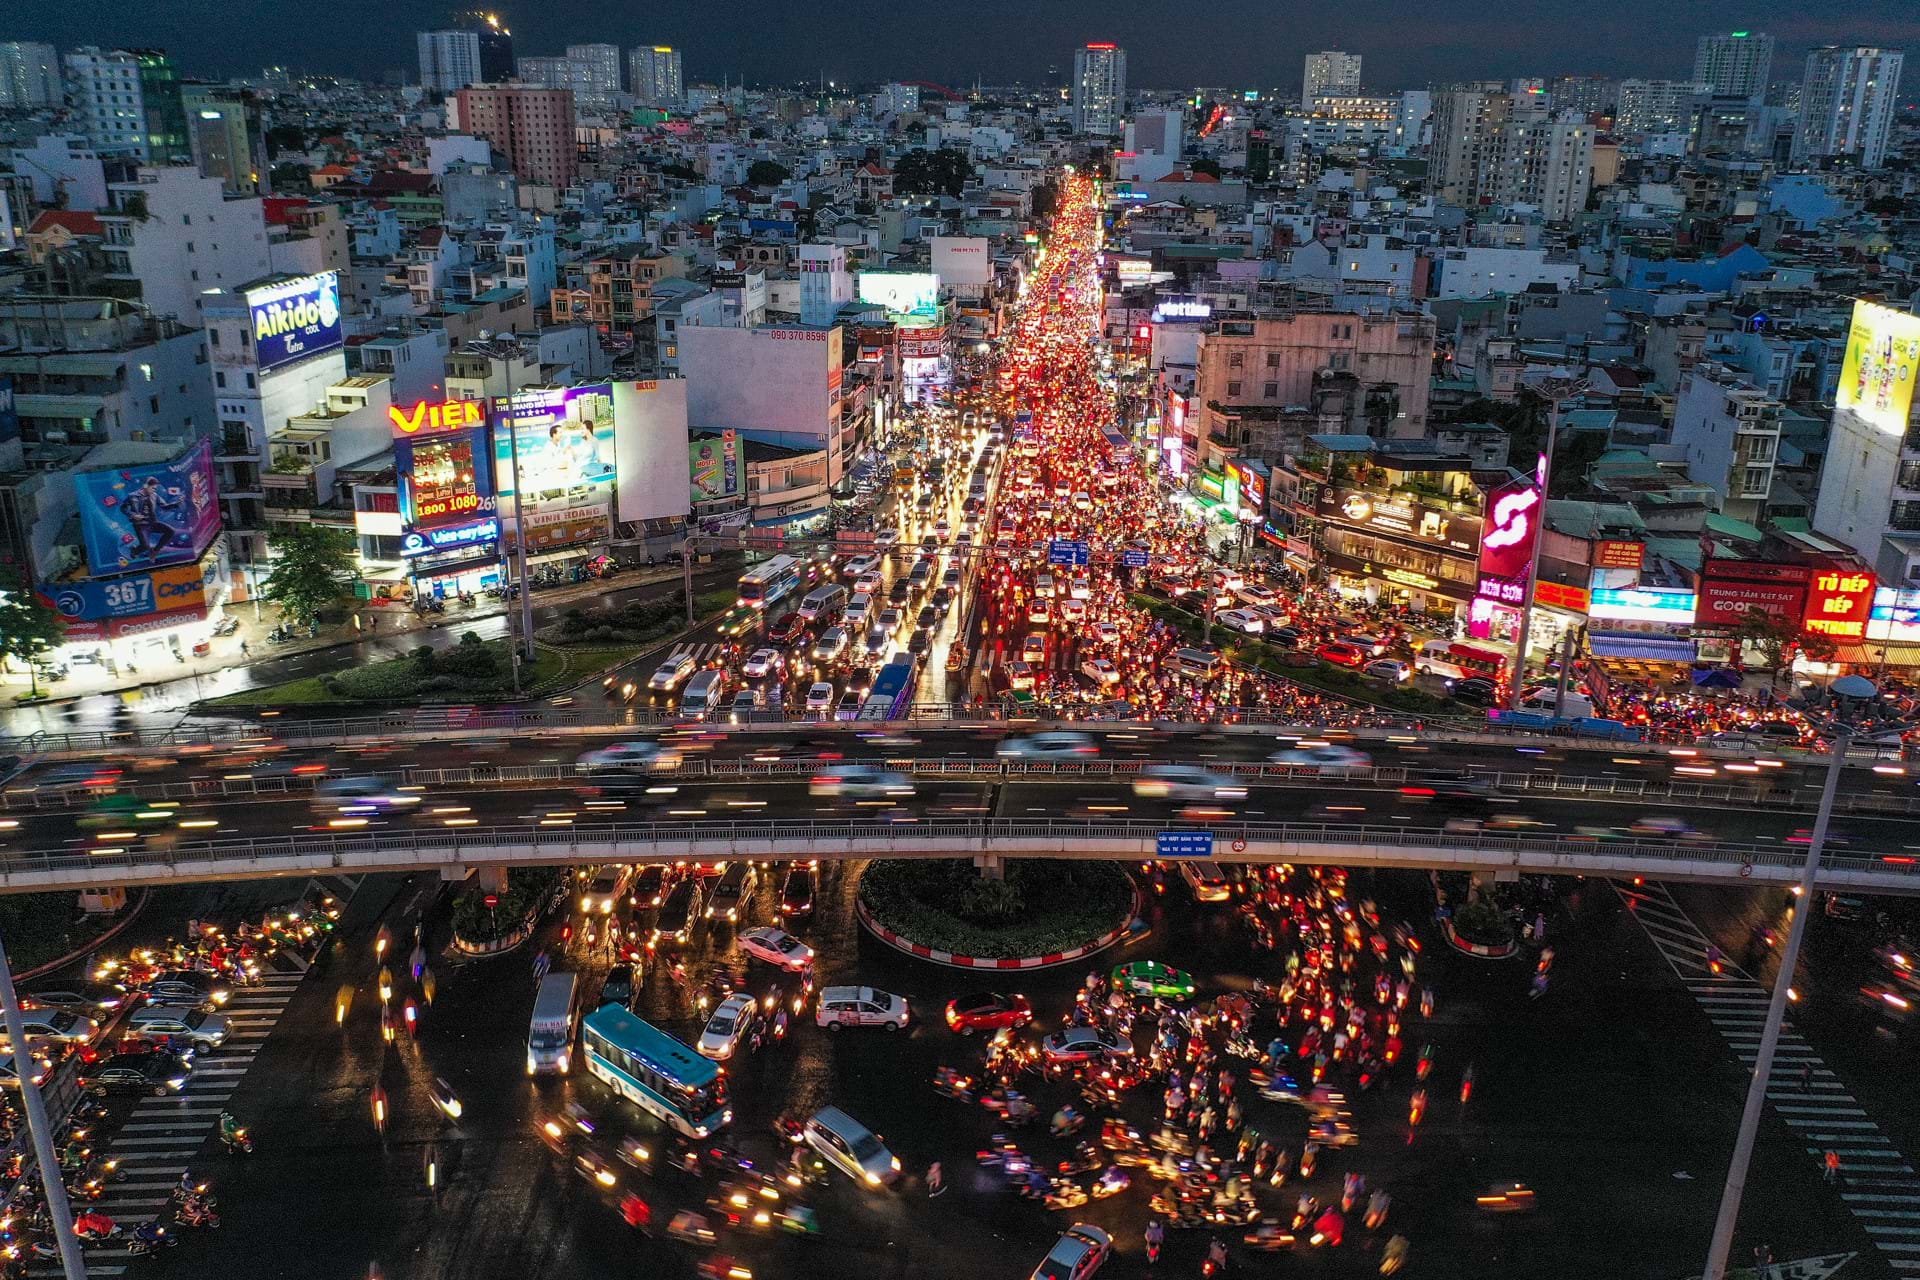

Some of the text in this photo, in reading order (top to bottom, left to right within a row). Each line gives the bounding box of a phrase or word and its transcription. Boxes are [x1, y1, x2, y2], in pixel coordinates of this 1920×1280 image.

[256, 296, 319, 340] Aikido
[771, 330, 826, 342] 090 370 8596
[389, 400, 485, 433] VIỆN
[418, 495, 477, 517] 1800 1080
[104, 578, 150, 607] 367
[1839, 574, 1869, 592] BẾP
[1709, 588, 1738, 598] TRUNG
[1740, 589, 1758, 599] TÂM
[1823, 595, 1853, 613] BẾP
